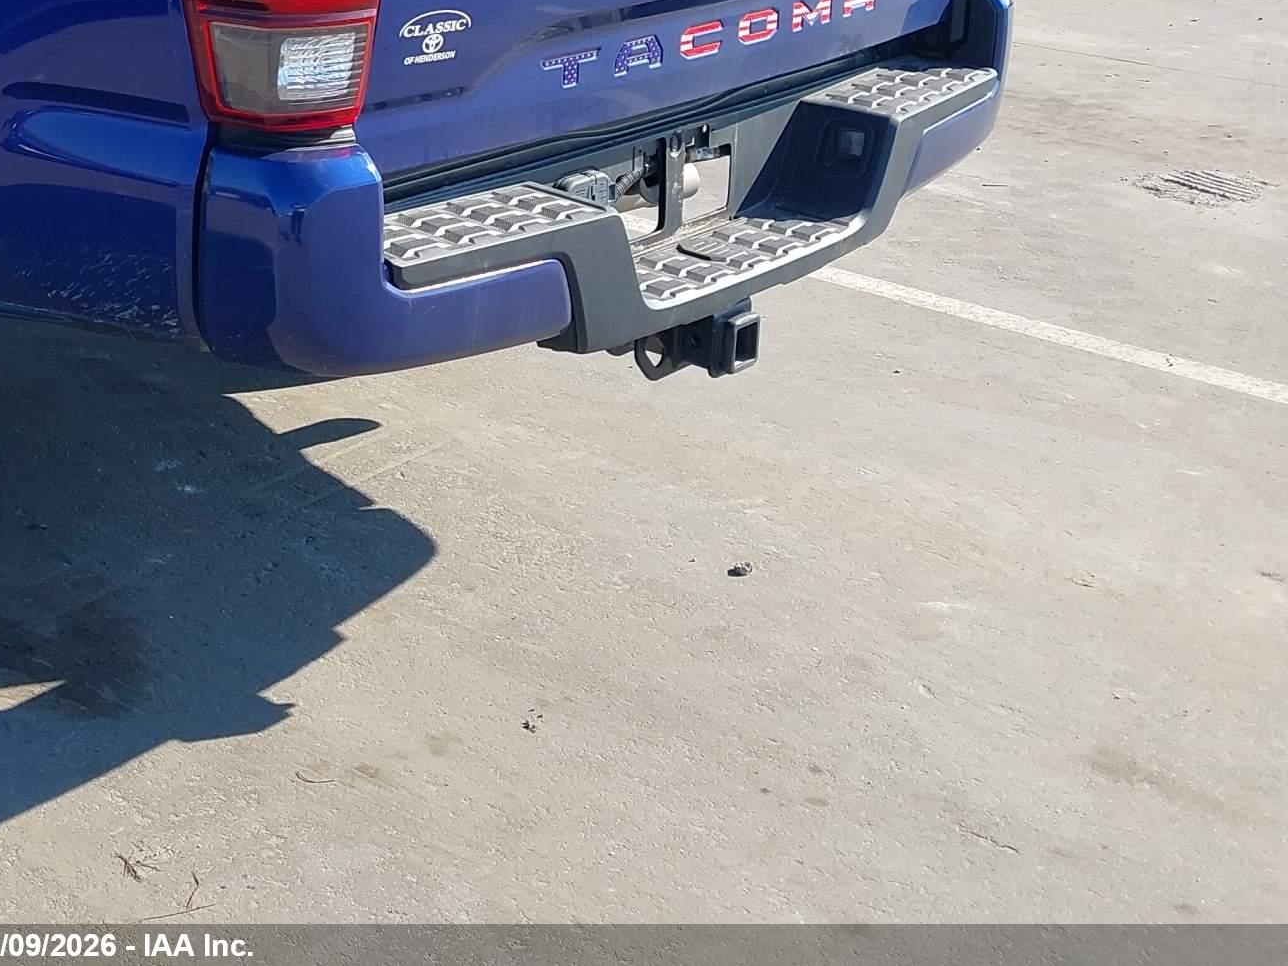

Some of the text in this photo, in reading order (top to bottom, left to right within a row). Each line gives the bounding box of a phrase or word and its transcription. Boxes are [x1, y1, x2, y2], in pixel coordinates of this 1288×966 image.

[403, 19, 467, 37] CLASSIC
[403, 50, 456, 65] OF HENDERSON
